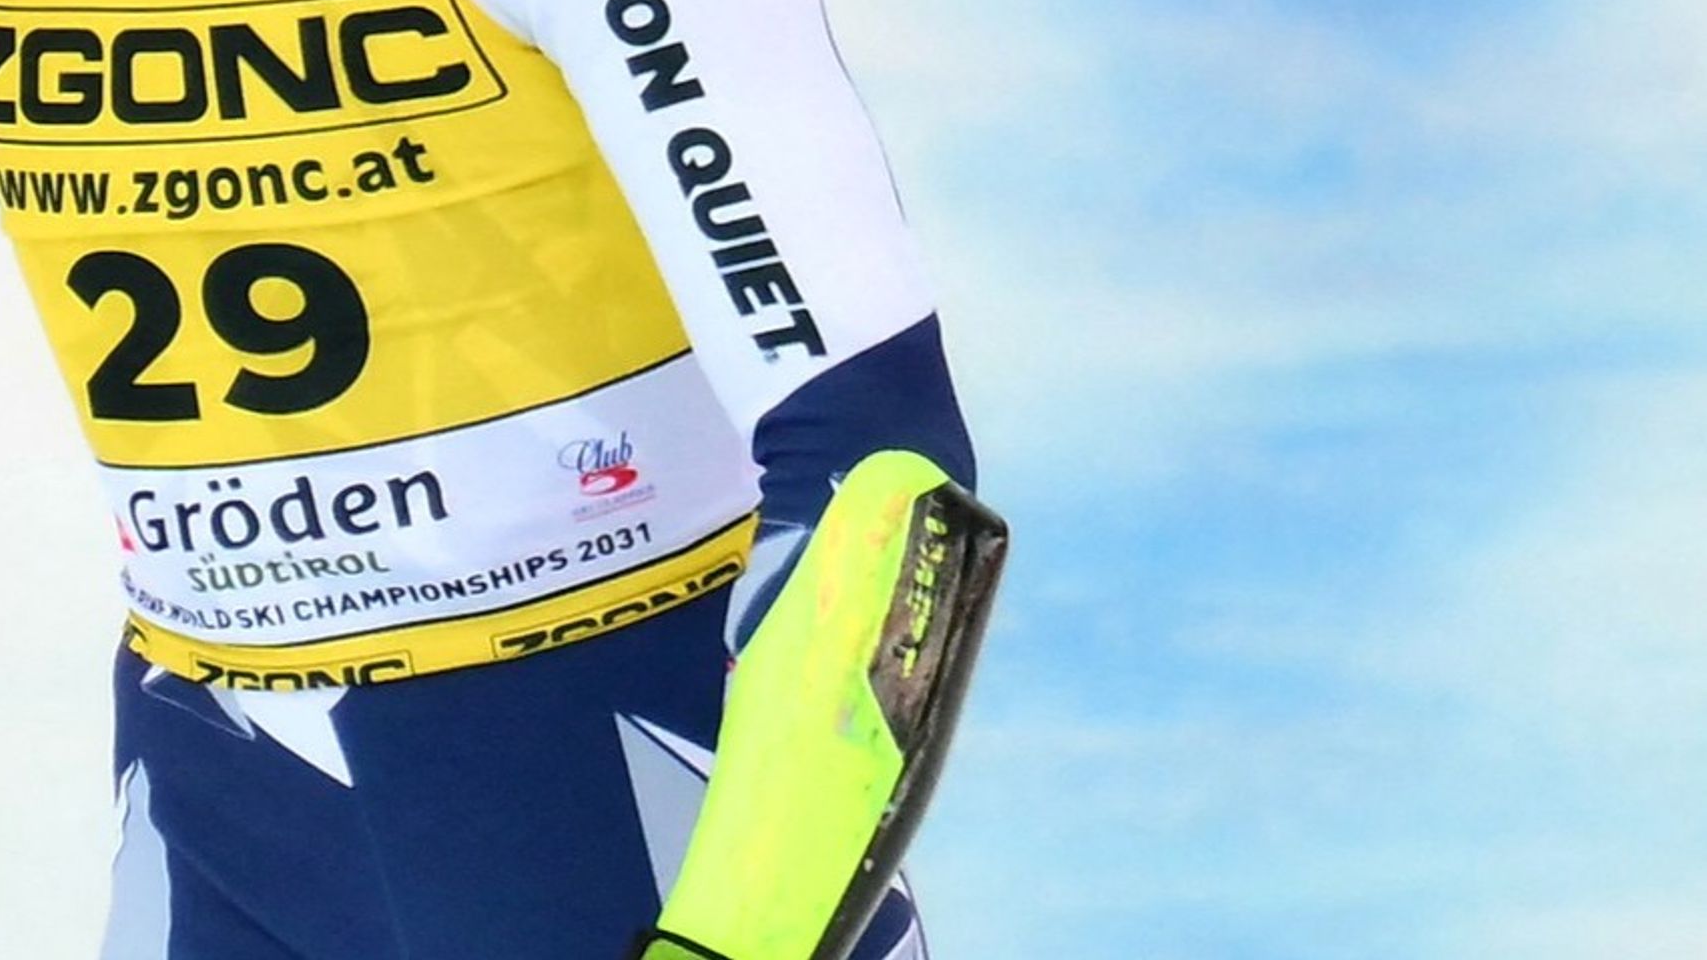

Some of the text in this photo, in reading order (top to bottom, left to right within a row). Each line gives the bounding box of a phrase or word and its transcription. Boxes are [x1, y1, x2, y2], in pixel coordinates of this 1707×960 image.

[666, 127, 828, 359] QUIET
[65, 242, 371, 420] 29
[129, 468, 449, 554] Gröden
[235, 604, 286, 630] SKI
[293, 548, 569, 623] CHAMPIONSHIPS
[577, 521, 654, 563] 2031
